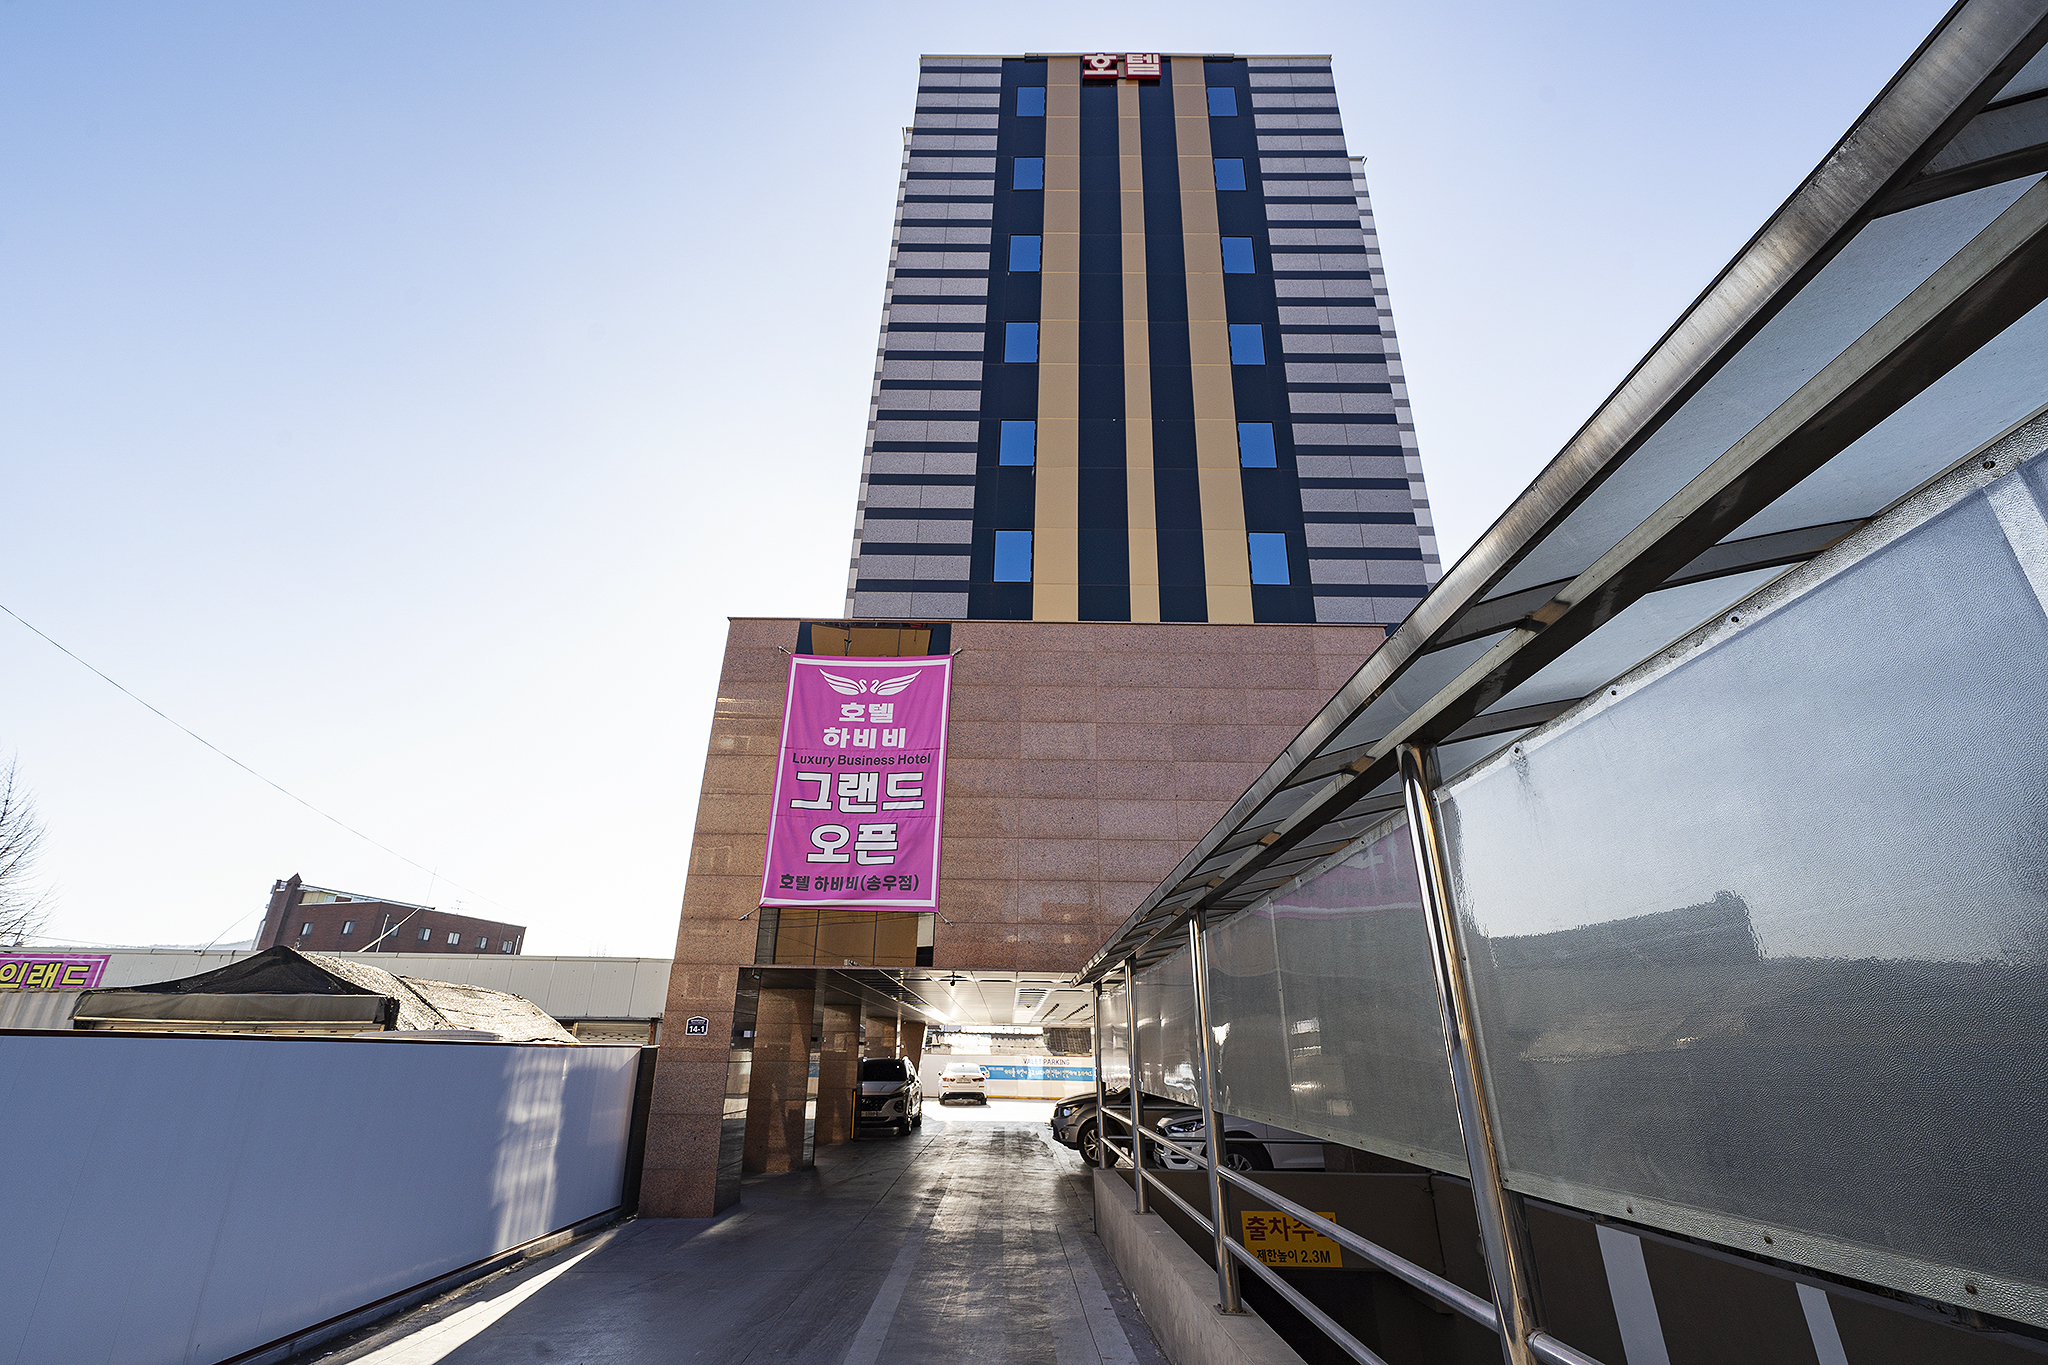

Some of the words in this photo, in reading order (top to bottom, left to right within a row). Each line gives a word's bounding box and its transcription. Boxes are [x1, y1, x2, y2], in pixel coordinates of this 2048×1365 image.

[1082, 53, 1161, 79] 호텔
[838, 702, 894, 723] 호텔
[822, 727, 906, 749] 하비비
[792, 753, 835, 768] Luxury
[837, 754, 895, 766] Business
[897, 753, 931, 765] Hotel
[790, 771, 925, 813] 그랜드
[806, 822, 898, 866] 오픈
[779, 873, 810, 892] 호텔
[814, 874, 920, 892] 하비비(송우점)
[689, 1025, 705, 1033] 14-1
[1043, 1058, 1070, 1066] PARKING
[1245, 1216, 1336, 1243] 출차주
[1256, 1249, 1298, 1263] 제한높이
[1300, 1249, 1331, 1264] 2.3M
